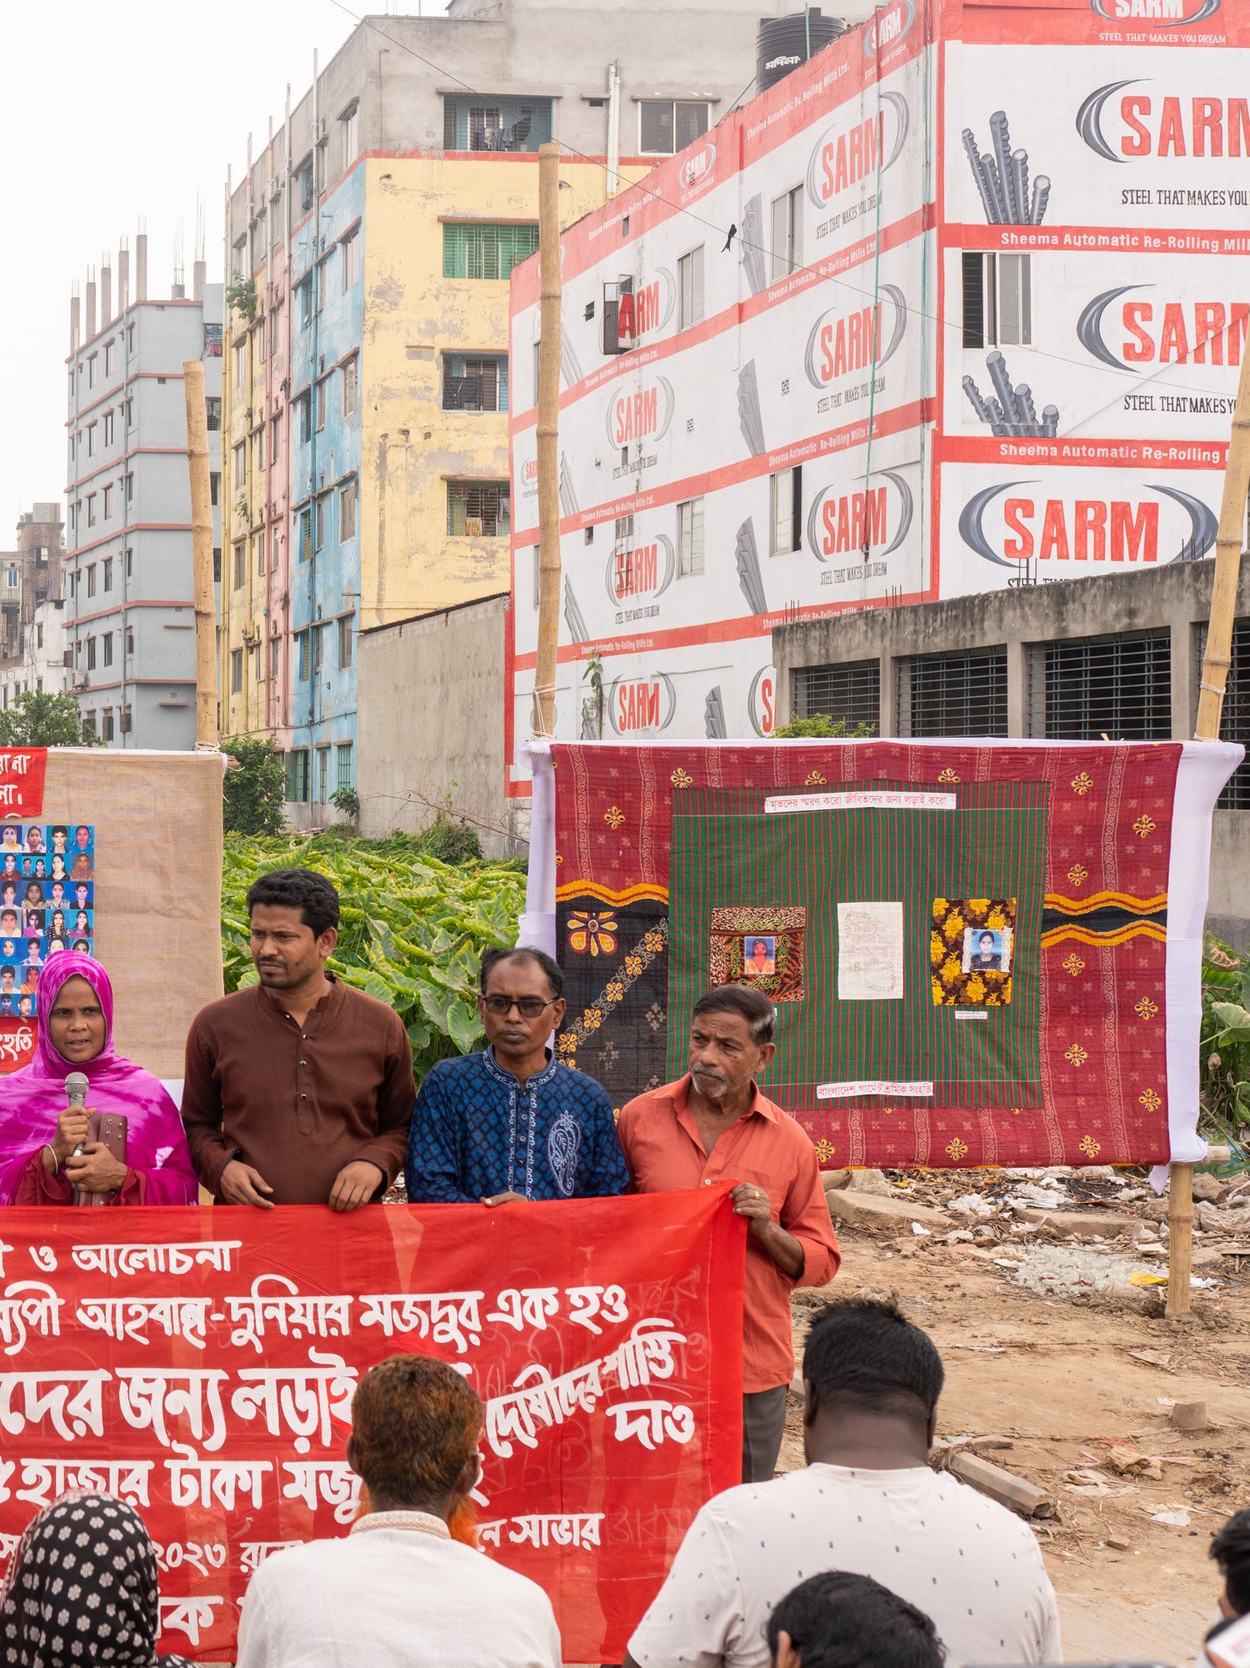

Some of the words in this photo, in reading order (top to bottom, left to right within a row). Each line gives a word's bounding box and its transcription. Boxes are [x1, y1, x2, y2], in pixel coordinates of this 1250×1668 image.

[1099, 33, 1123, 42] STEEL
[1126, 33, 1147, 42] THAT
[1150, 34, 1179, 43] MAKES
[1181, 35, 1197, 43] YOU
[1198, 35, 1227, 44] DREAM
[1122, 189, 1154, 206] STEEL
[1157, 190, 1186, 206] THAT
[1187, 190, 1226, 206] MAKES
[1001, 232, 1059, 246] Sheema
[1063, 233, 1140, 248] Automatic
[1144, 235, 1219, 253] Re-Rolling
[821, 301, 883, 382] SARM
[616, 387, 657, 443] SARM
[1124, 395, 1156, 411] STEEL
[1159, 396, 1188, 412] THAT
[1189, 398, 1227, 414] MAKES
[1000, 443, 1058, 458] Sheema
[1062, 445, 1138, 459] Automatic
[1142, 447, 1220, 464] Re-Rolling
[822, 487, 887, 556] SARM
[1004, 498, 1159, 562] SARM
[618, 682, 659, 732] SARM
[11, 754, 31, 775] না
[770, 799, 798, 811] মৃতদের
[823, 796, 842, 807] করো
[845, 792, 883, 806] জীবিতদের
[904, 793, 925, 806] লড়াই
[928, 795, 947, 806] করো
[819, 1085, 857, 1098] বাংলাদেশ
[885, 1082, 907, 1095] শ্রমিক
[909, 1082, 933, 1094] সংহতি
[29, 1245, 58, 1273] ও
[72, 1240, 242, 1278] আলোচনা
[359, 1290, 485, 1354] মজদুর
[487, 1287, 559, 1332] এক
[565, 1284, 629, 1335] হও
[115, 1367, 230, 1451] জন্য
[231, 1346, 361, 1454] লড়াই
[485, 1363, 603, 1458] দোষীদের
[601, 1318, 687, 1390] শাস্তি
[605, 1400, 695, 1450] দাও
[163, 1440, 273, 1511] টাকা
[509, 1512, 606, 1551] সাভার
